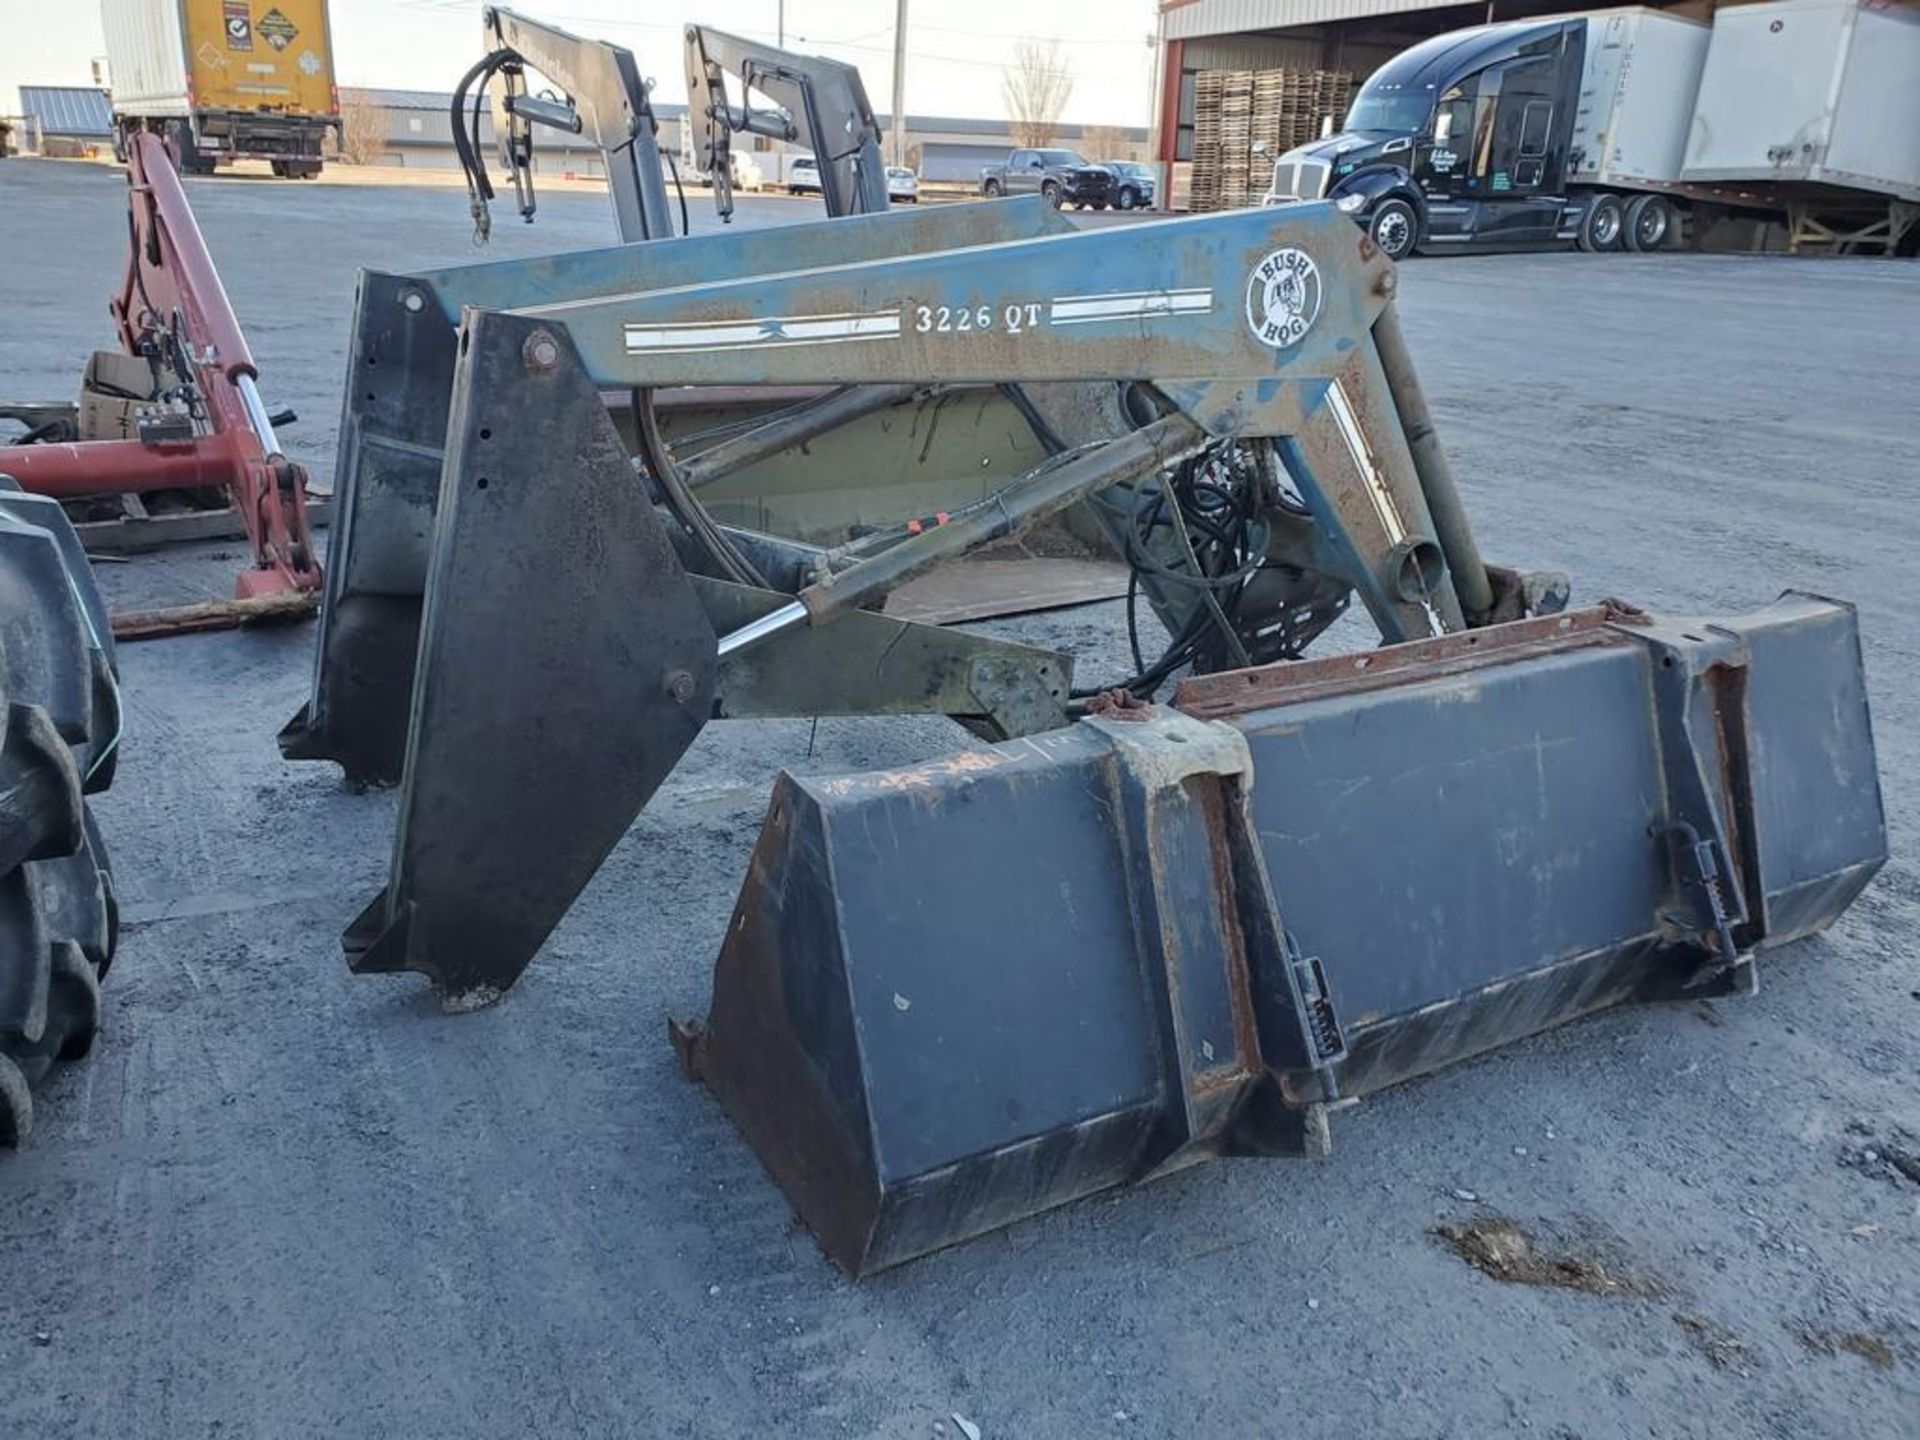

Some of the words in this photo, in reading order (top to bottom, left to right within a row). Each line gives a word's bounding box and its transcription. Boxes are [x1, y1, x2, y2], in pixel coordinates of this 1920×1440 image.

[1261, 253, 1309, 280] BUSH
[916, 305, 991, 332] 3226
[1004, 303, 1041, 333] QT
[1264, 319, 1303, 341] HOG
